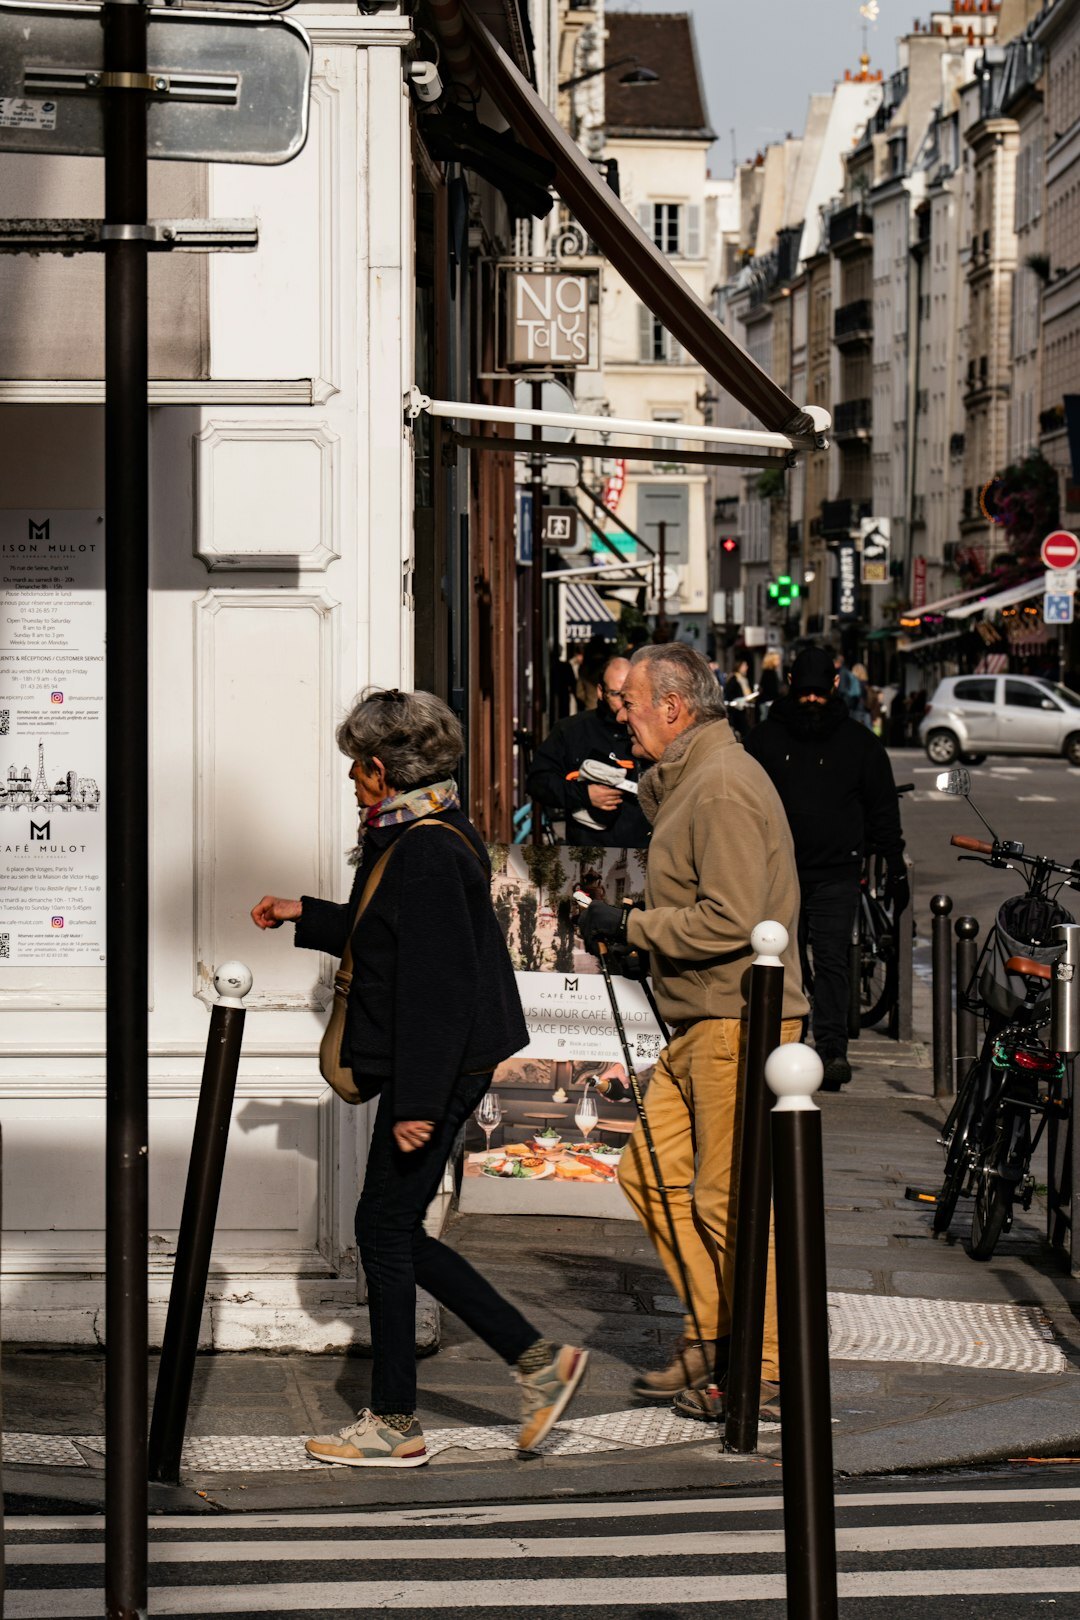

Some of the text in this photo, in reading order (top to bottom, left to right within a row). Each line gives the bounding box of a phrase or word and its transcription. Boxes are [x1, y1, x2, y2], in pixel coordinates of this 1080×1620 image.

[48, 544, 96, 552] MULOT
[0, 844, 29, 852] AFÉ
[523, 1008, 537, 1017] US
[541, 1008, 552, 1017] IN
[555, 1009, 578, 1019] OUR
[582, 1008, 607, 1020] CAFÉ
[560, 1025, 580, 1034] DES
[583, 1026, 620, 1036] VOSGE
